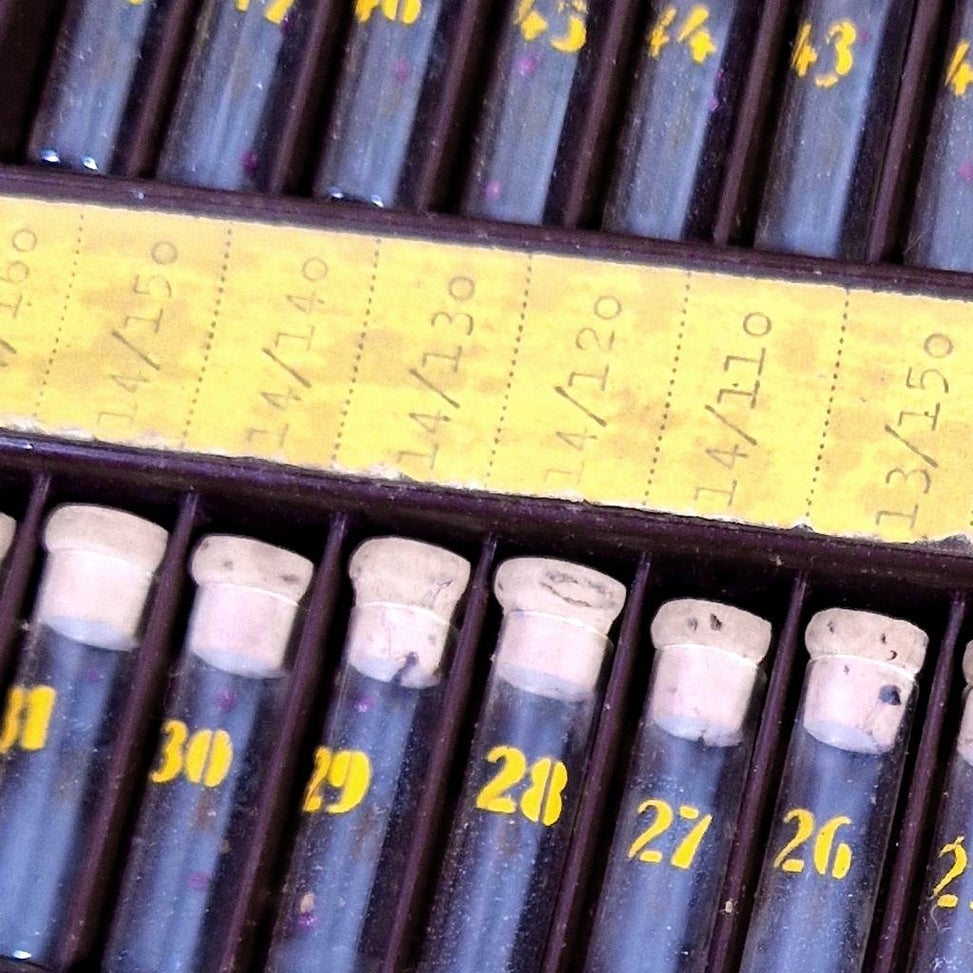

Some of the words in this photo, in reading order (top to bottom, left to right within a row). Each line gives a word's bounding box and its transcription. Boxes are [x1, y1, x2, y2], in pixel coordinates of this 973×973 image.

[792, 21, 856, 88] 43
[97, 240, 178, 427] 14/150
[248, 256, 329, 449] 14/140
[397, 276, 476, 471] 14/130
[543, 295, 623, 487] 14/120
[693, 311, 772, 506] 14/110
[875, 333, 953, 530] 13/150
[150, 719, 232, 788] 30
[475, 745, 568, 827] 28
[627, 798, 712, 869] 27
[774, 807, 852, 880] 26
